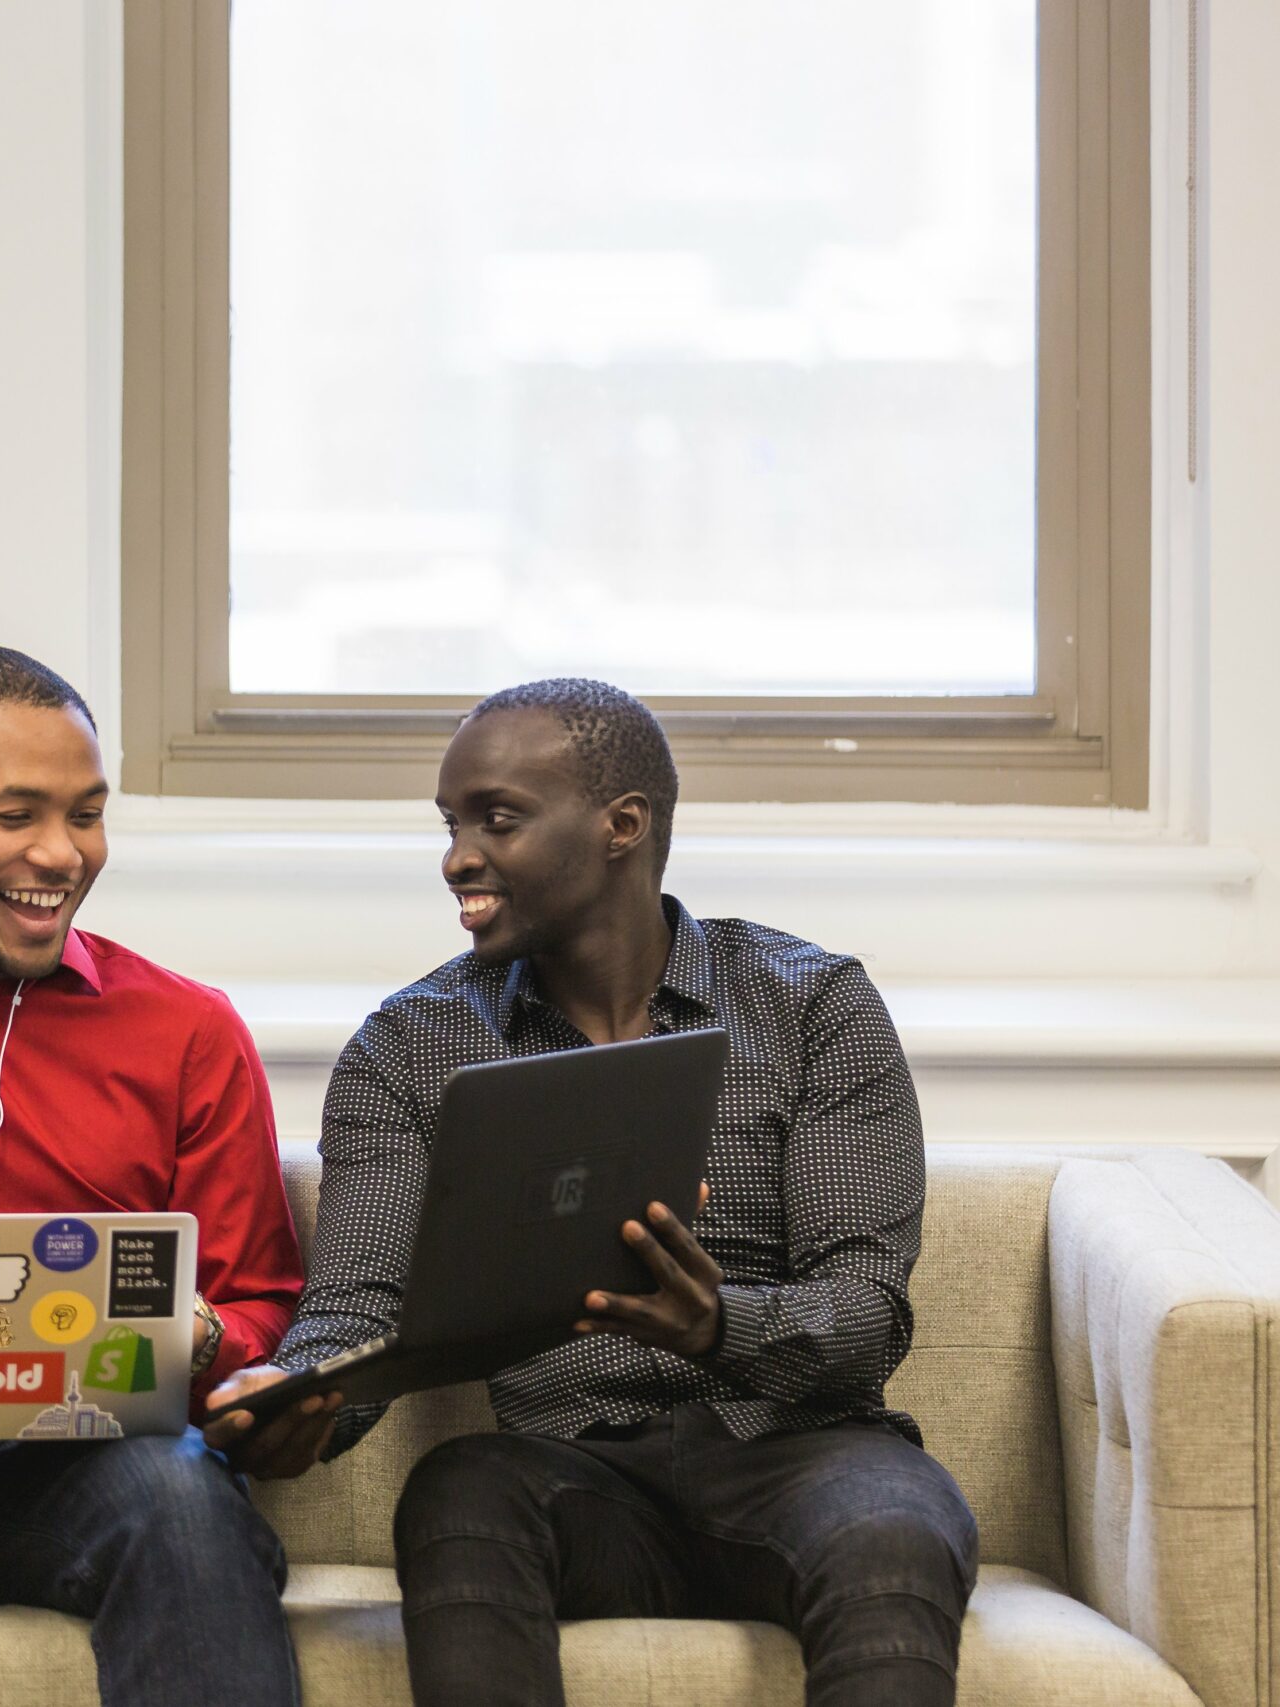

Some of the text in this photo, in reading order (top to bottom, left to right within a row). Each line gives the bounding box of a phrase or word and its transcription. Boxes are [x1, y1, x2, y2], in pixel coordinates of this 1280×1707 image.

[47, 1240, 84, 1250] POWER
[118, 1239, 154, 1249] Make
[118, 1252, 154, 1262] tech
[117, 1266, 153, 1276] more
[117, 1277, 168, 1288] Black.
